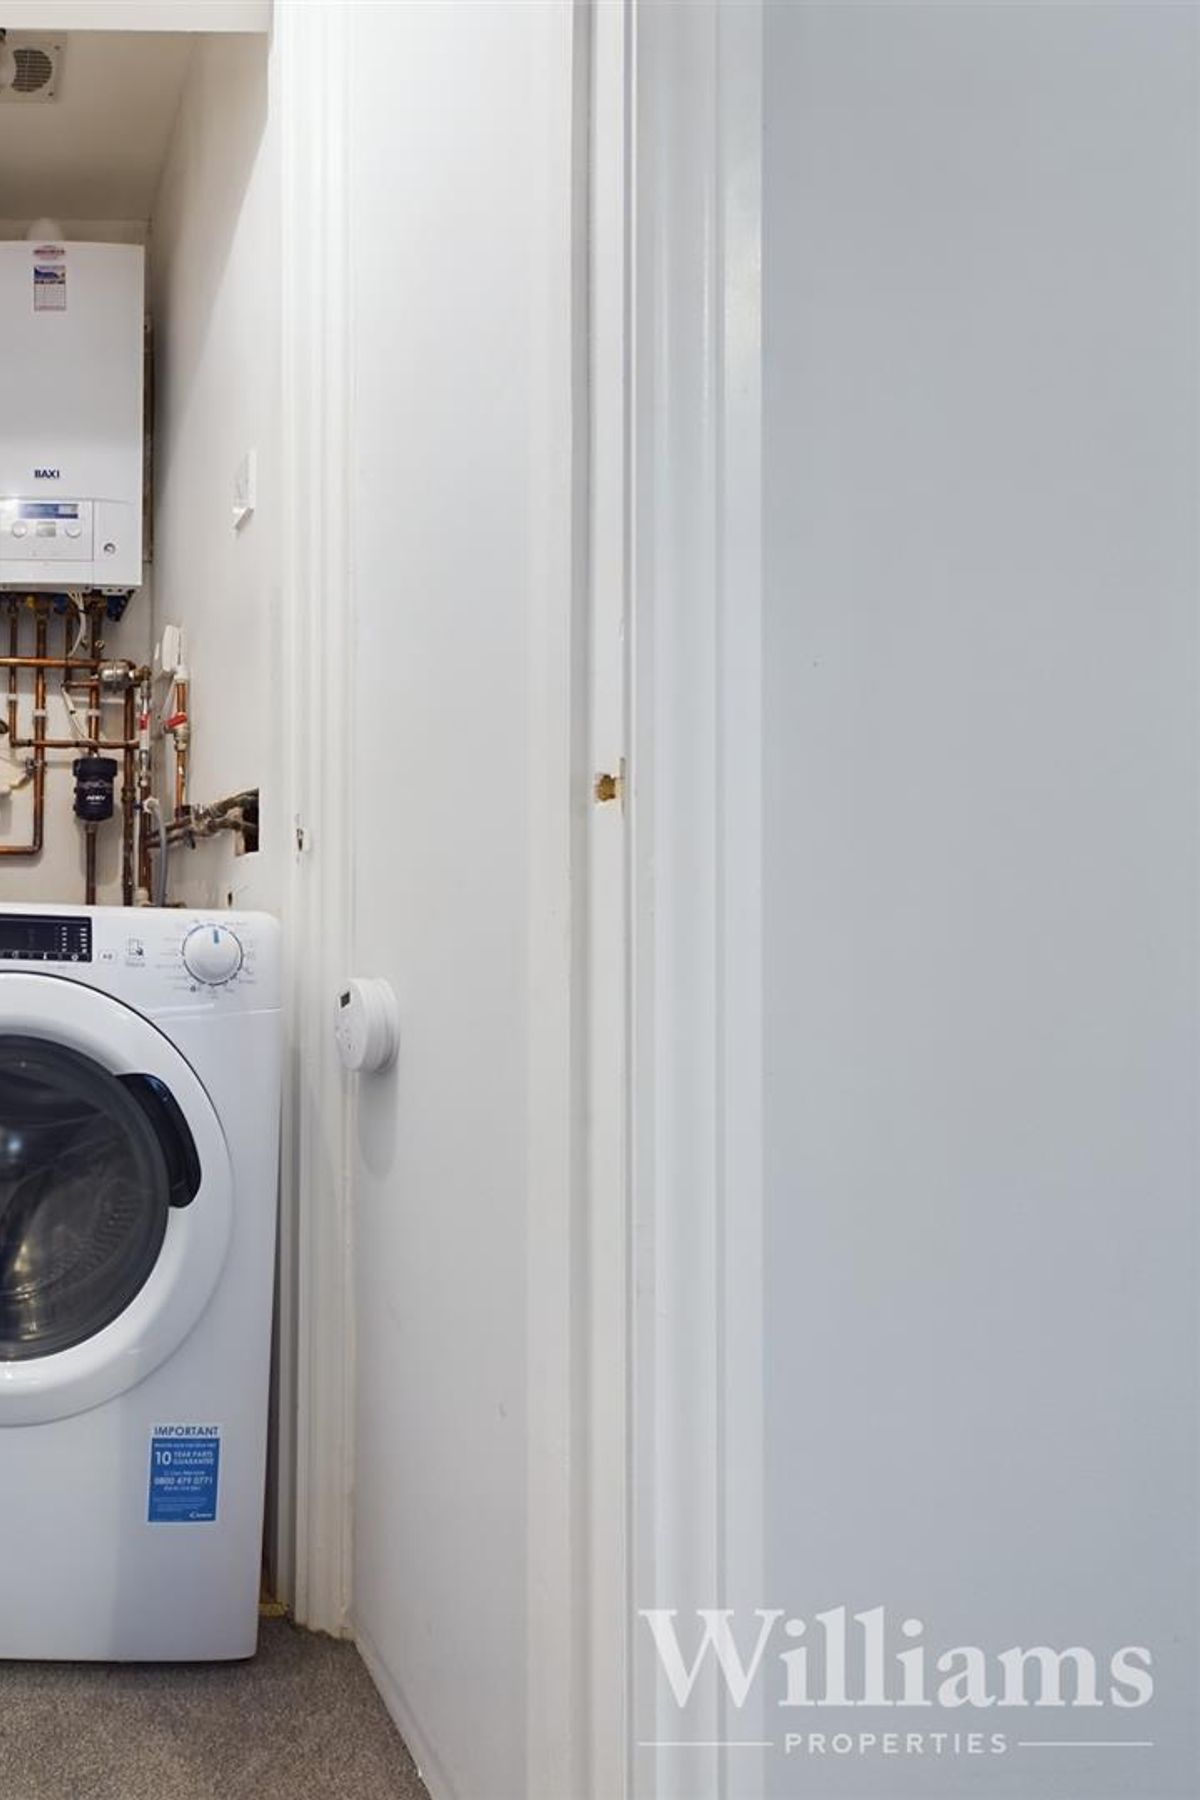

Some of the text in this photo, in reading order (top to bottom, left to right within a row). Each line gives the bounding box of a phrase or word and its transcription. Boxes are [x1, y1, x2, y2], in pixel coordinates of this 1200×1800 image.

[34, 469, 60, 479] BAXI
[154, 1426, 219, 1436] IMPORTANT
[155, 1451, 172, 1466] 10
